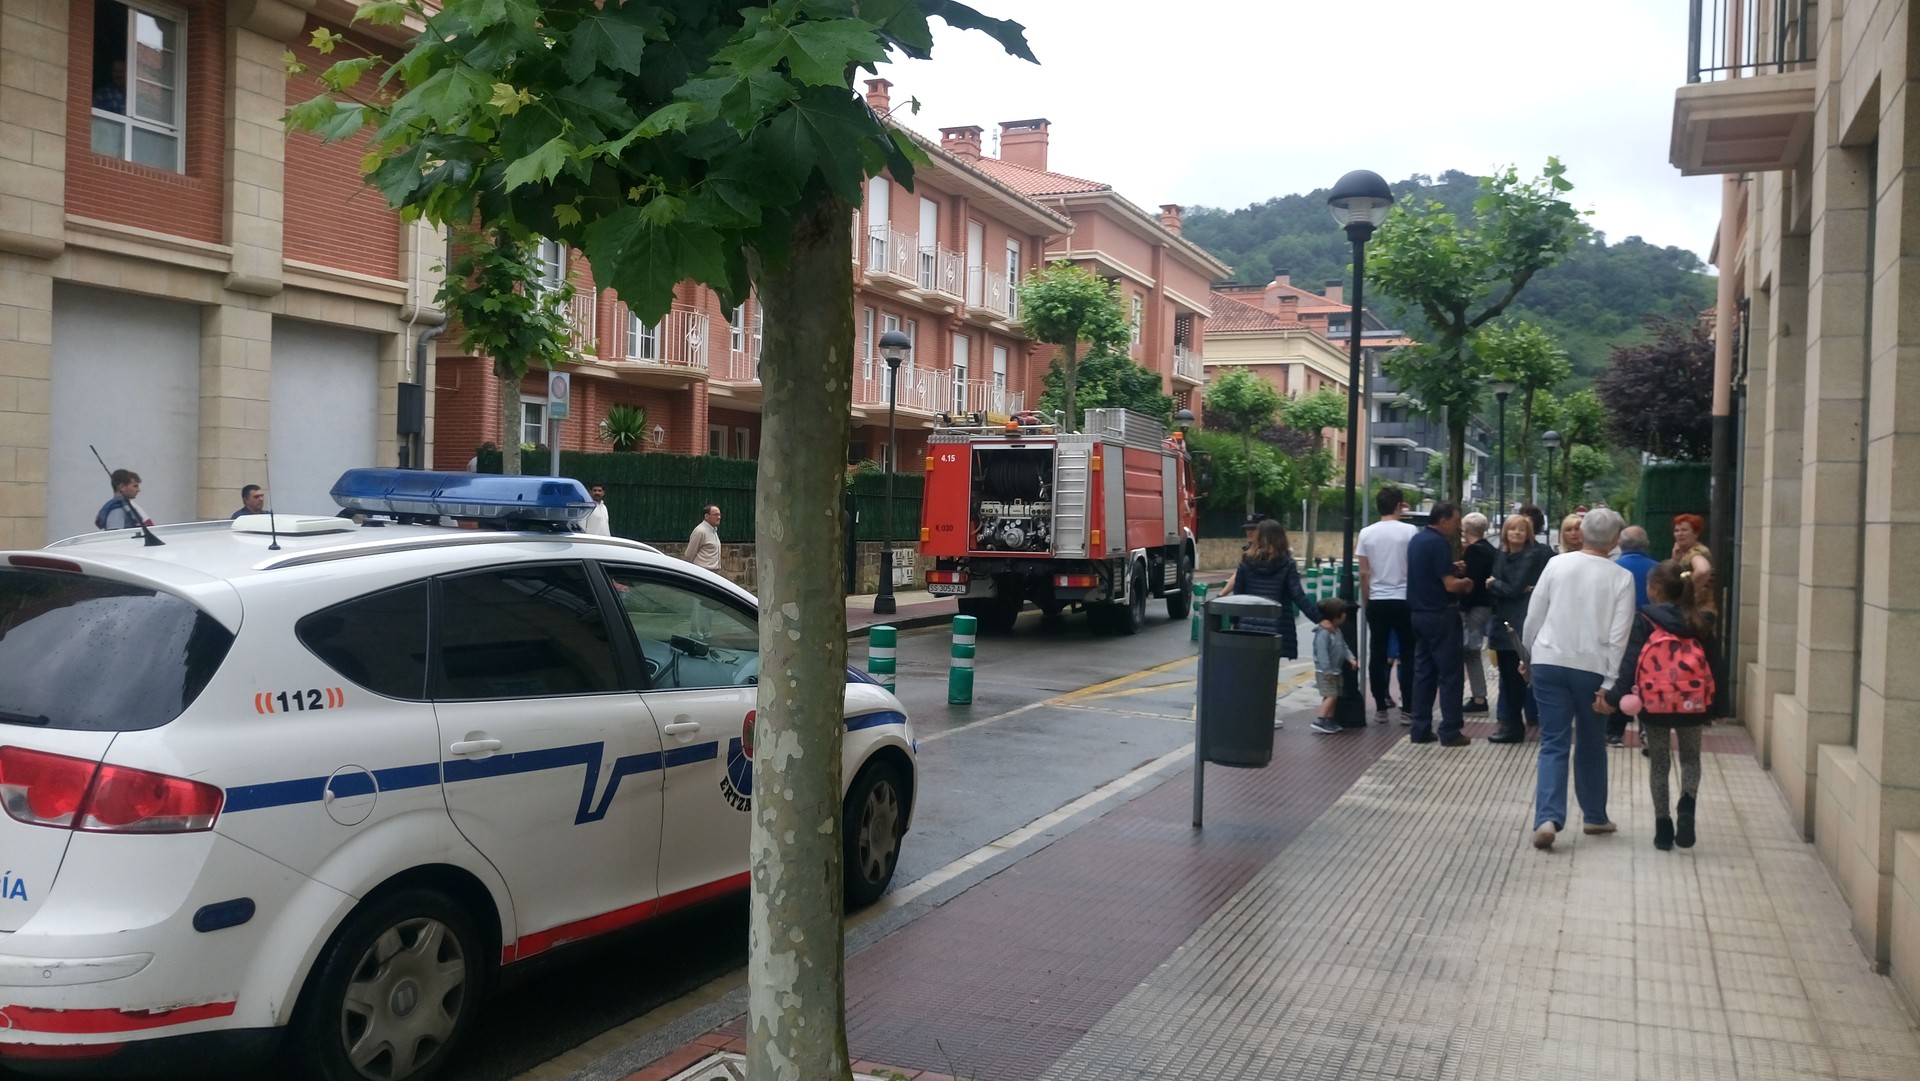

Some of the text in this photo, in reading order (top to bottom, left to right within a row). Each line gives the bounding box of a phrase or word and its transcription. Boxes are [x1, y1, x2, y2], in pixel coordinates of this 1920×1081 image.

[941, 454, 956, 462] 4.15
[276, 689, 324, 712] 112
[719, 775, 752, 812] ERTZA
[0, 870, 28, 901] ÍA
